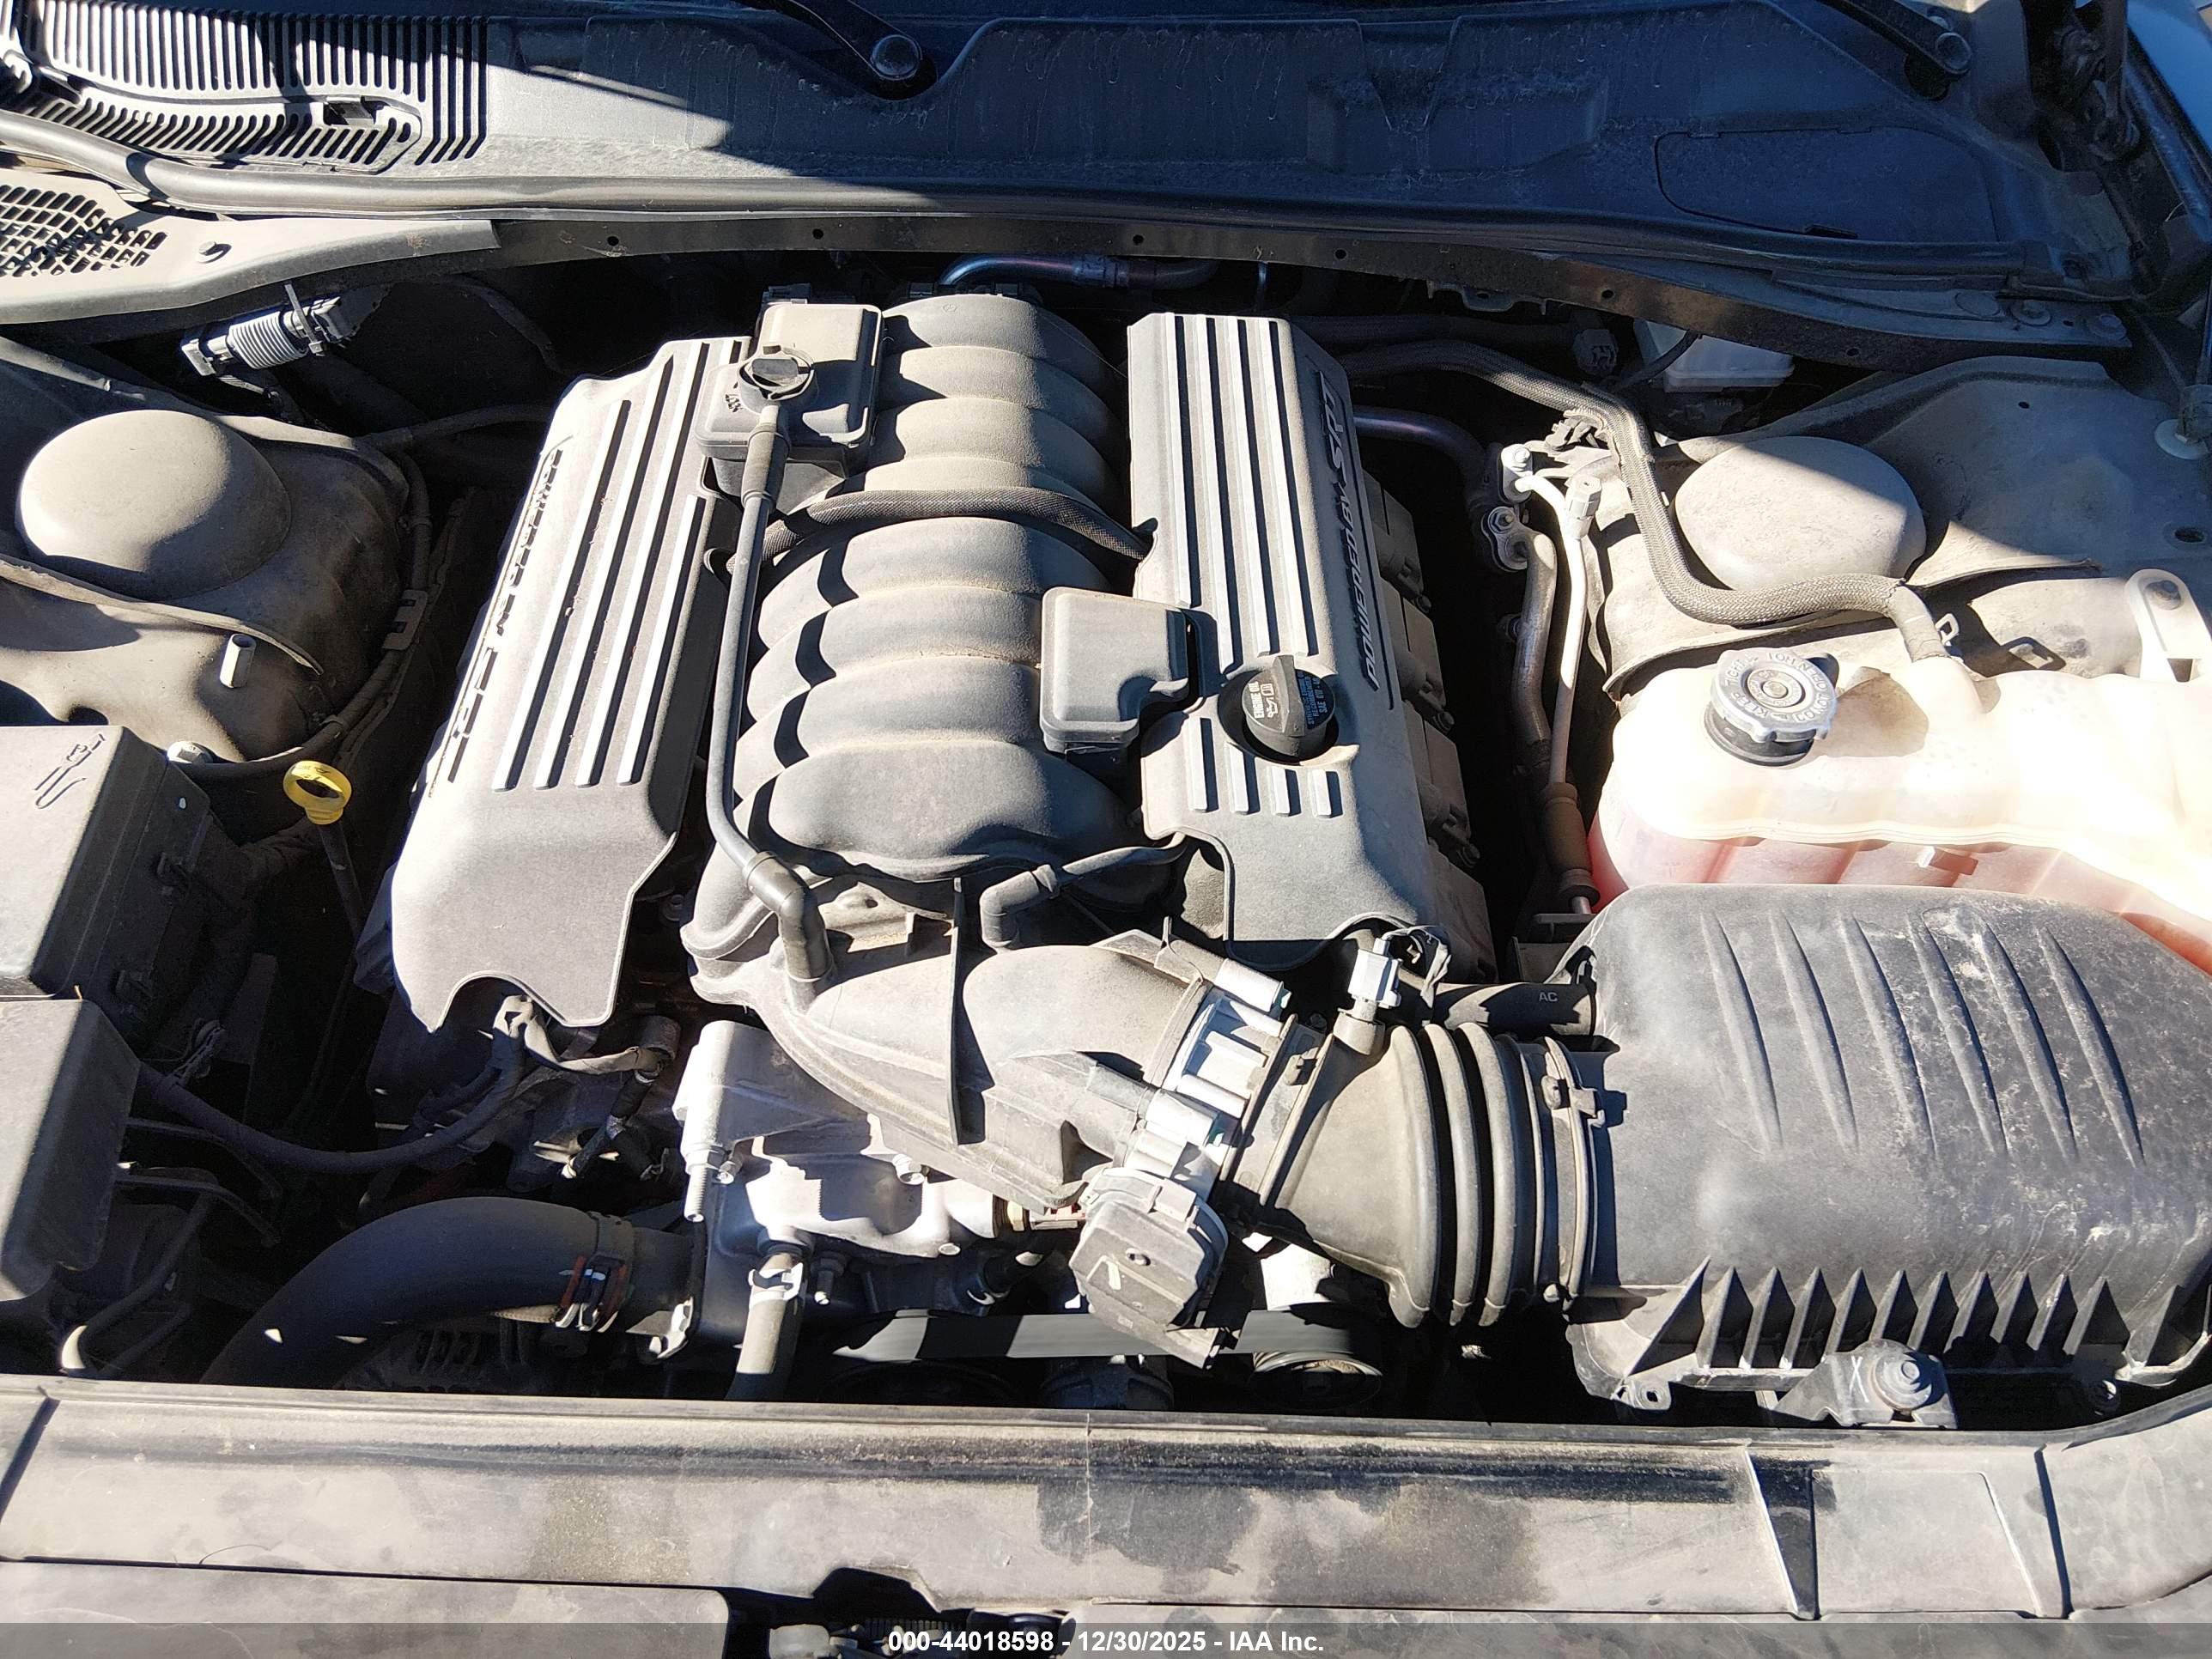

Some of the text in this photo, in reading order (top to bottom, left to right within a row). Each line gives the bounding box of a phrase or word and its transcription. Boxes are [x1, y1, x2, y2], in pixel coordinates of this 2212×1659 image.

[1320, 371, 1379, 691] POWERED BY SRT
[1248, 681, 1265, 719] ENGINE OIL
[1316, 701, 1328, 714] SAE
[1730, 692, 1769, 719] KEEP
[1539, 992, 1558, 1002] AC
